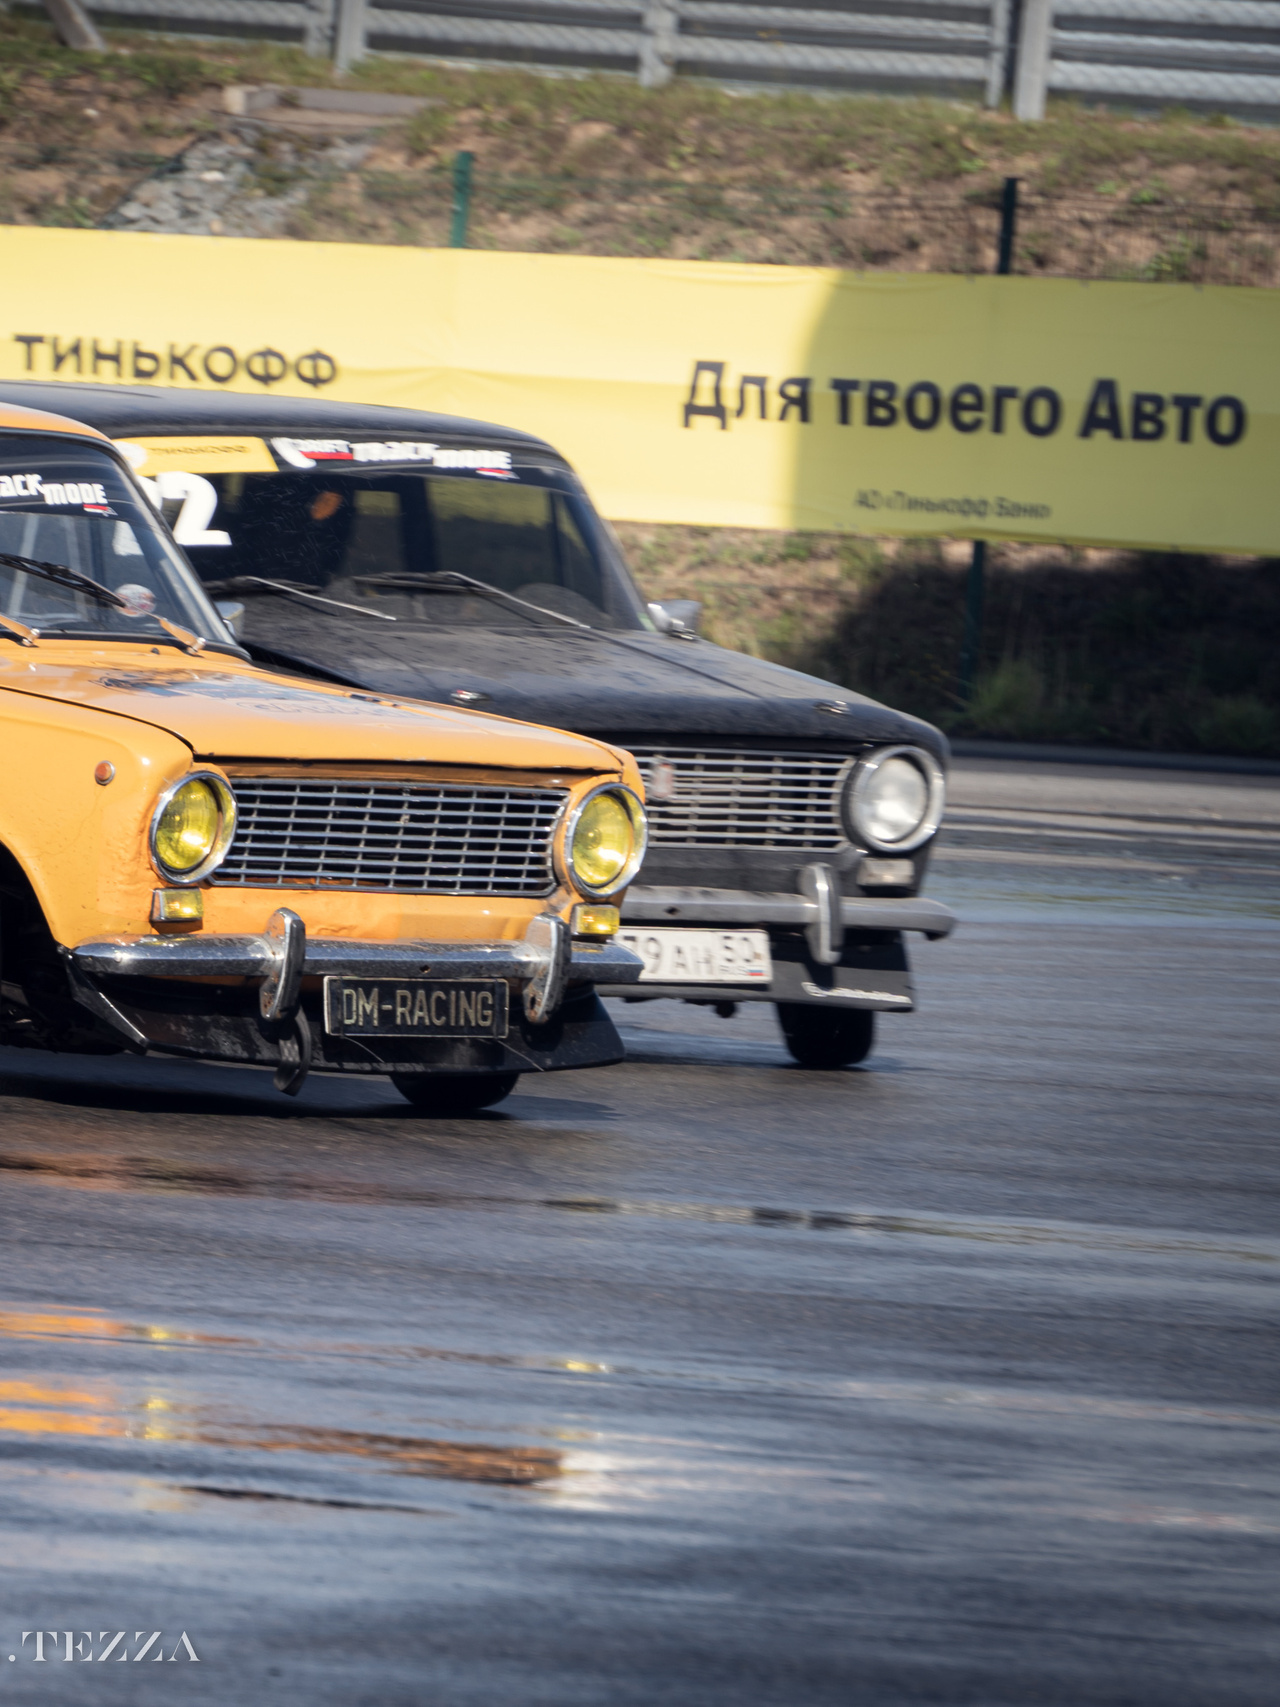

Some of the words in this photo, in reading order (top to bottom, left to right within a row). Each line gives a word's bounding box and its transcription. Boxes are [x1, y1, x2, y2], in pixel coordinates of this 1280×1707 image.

[13, 333, 338, 388] ТИНЬКОФФ
[683, 360, 812, 430] Для
[829, 377, 1063, 438] твоего
[1077, 377, 1248, 447] Авто
[41, 483, 108, 505] MODE
[342, 988, 493, 1028] DM-RACING
